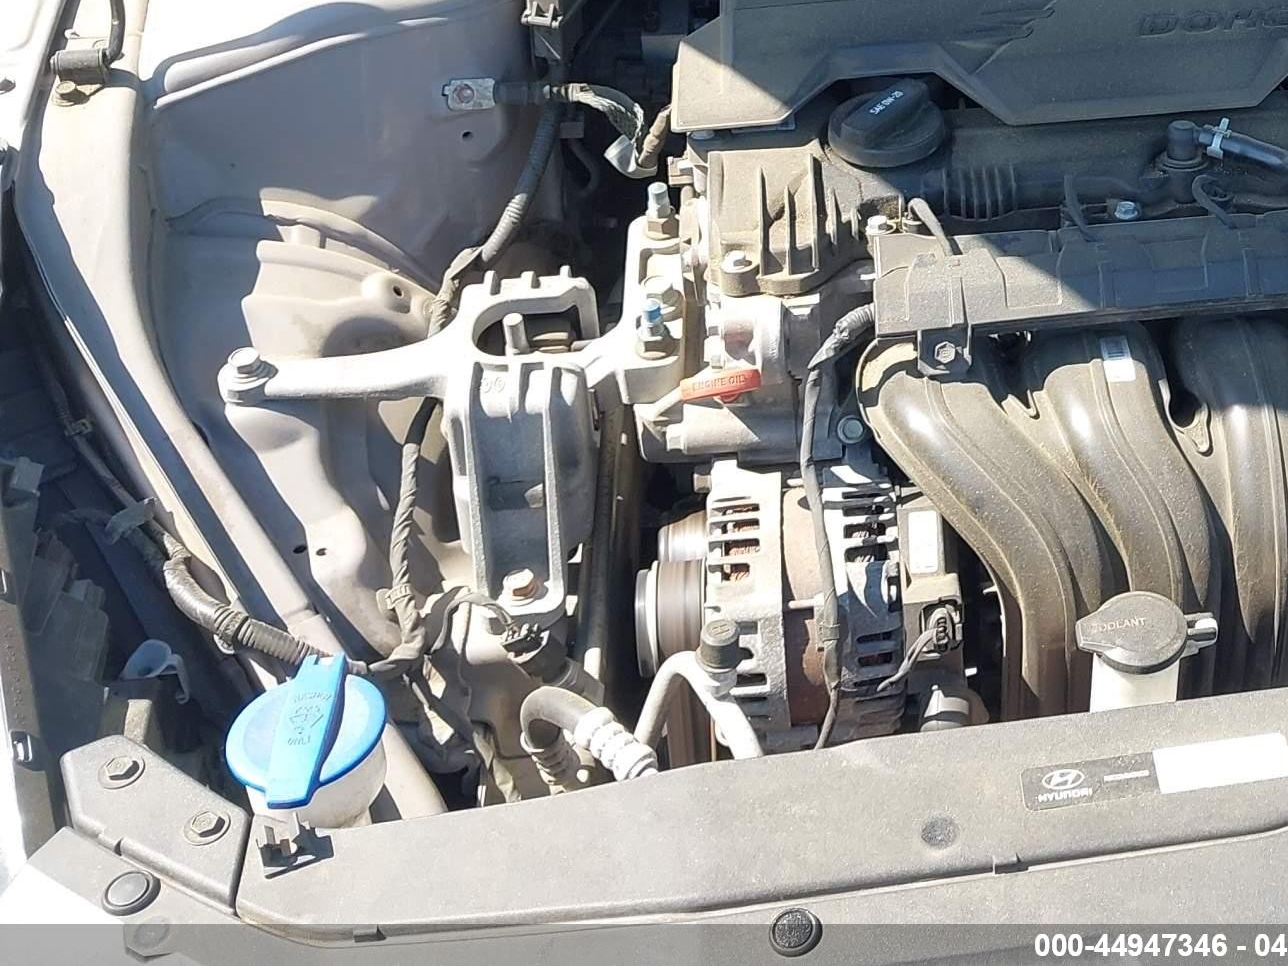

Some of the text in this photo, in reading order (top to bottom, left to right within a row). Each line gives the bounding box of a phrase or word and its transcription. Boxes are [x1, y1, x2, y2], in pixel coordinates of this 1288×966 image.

[869, 90, 904, 115] SAE 0W-20
[692, 374, 746, 391] ENGINE OIL
[1037, 787, 1093, 803] HYUNDAI
